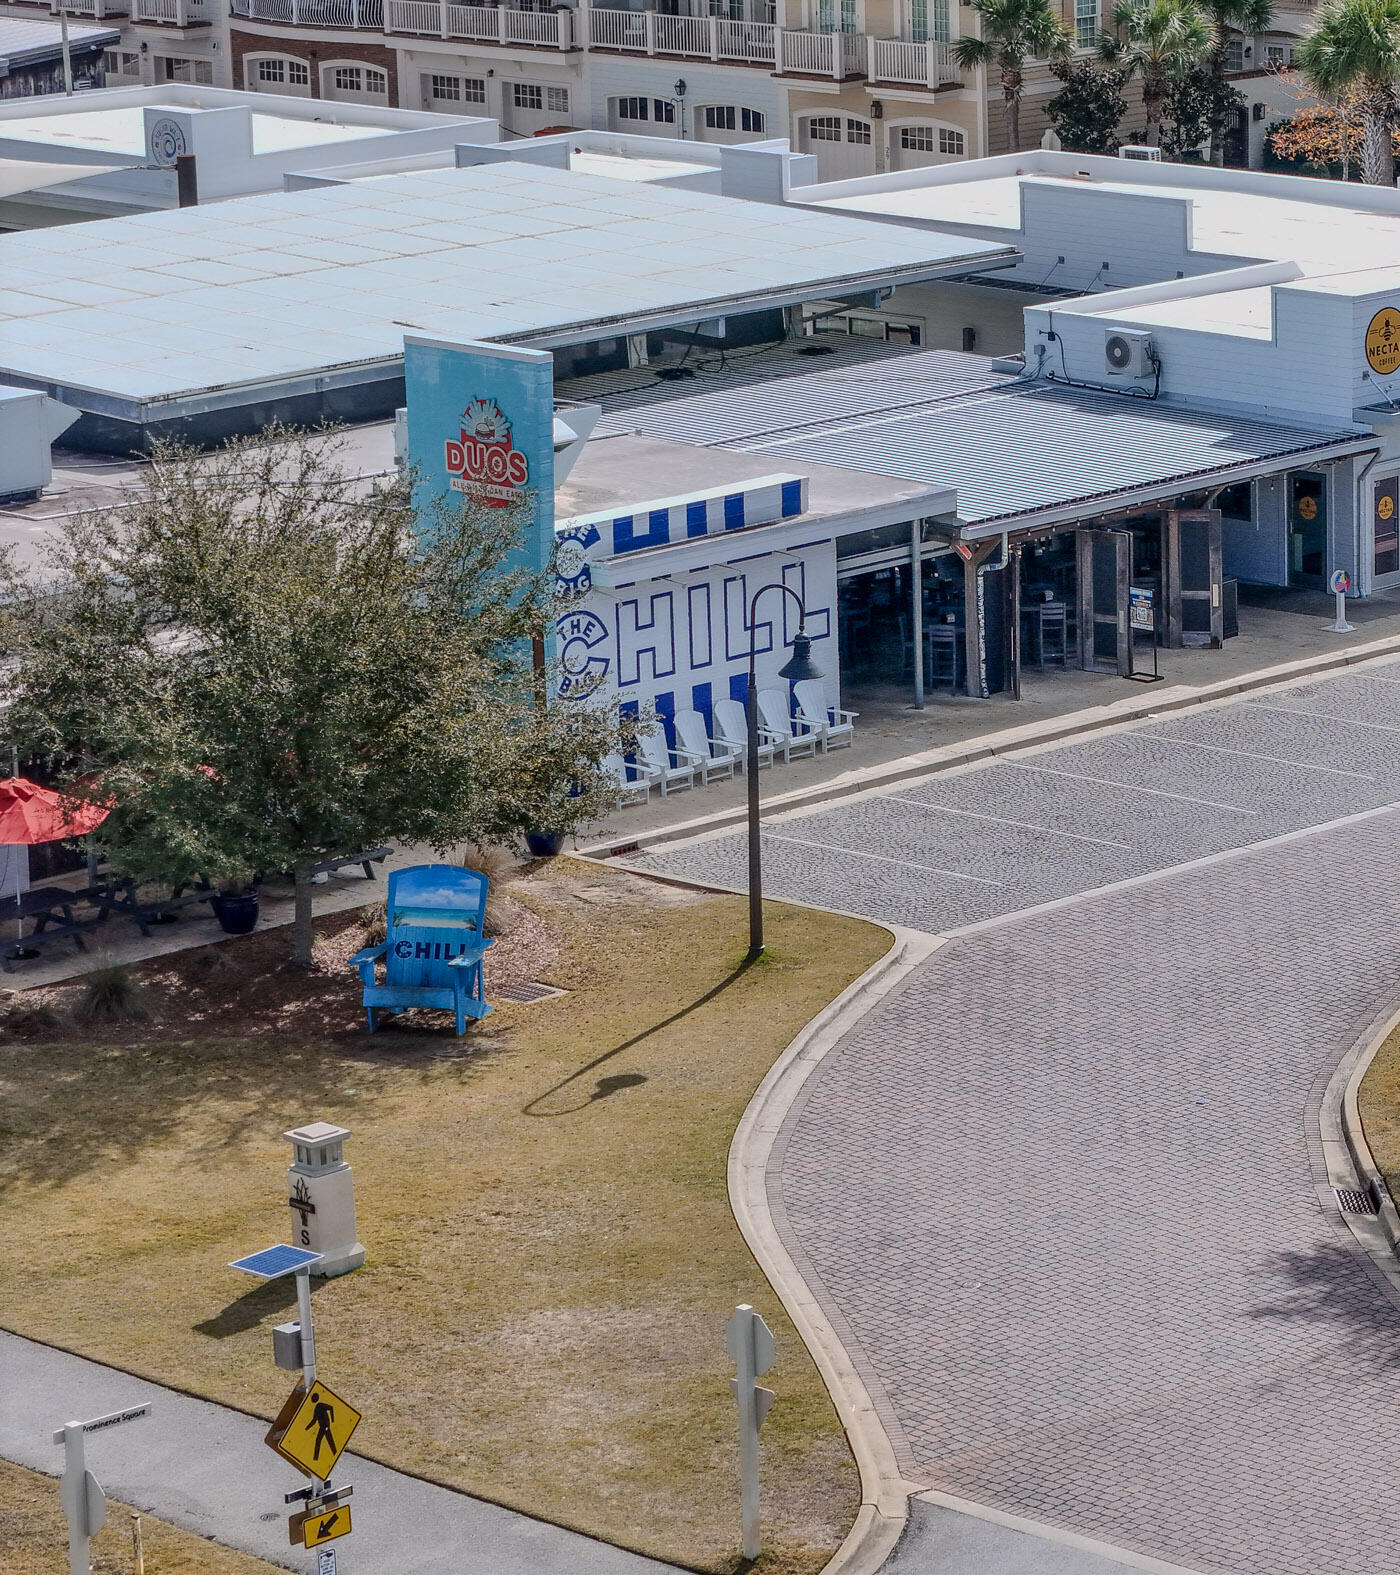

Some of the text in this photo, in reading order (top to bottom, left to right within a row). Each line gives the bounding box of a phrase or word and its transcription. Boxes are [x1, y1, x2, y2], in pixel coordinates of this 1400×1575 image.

[1379, 356, 1396, 366] COFFEE
[444, 440, 528, 485] DUOS
[555, 575, 590, 598] BIG
[556, 561, 831, 700] CHILL
[557, 618, 597, 641] THE
[301, 1229, 310, 1246] S
[82, 1408, 146, 1433] Prominence Square
